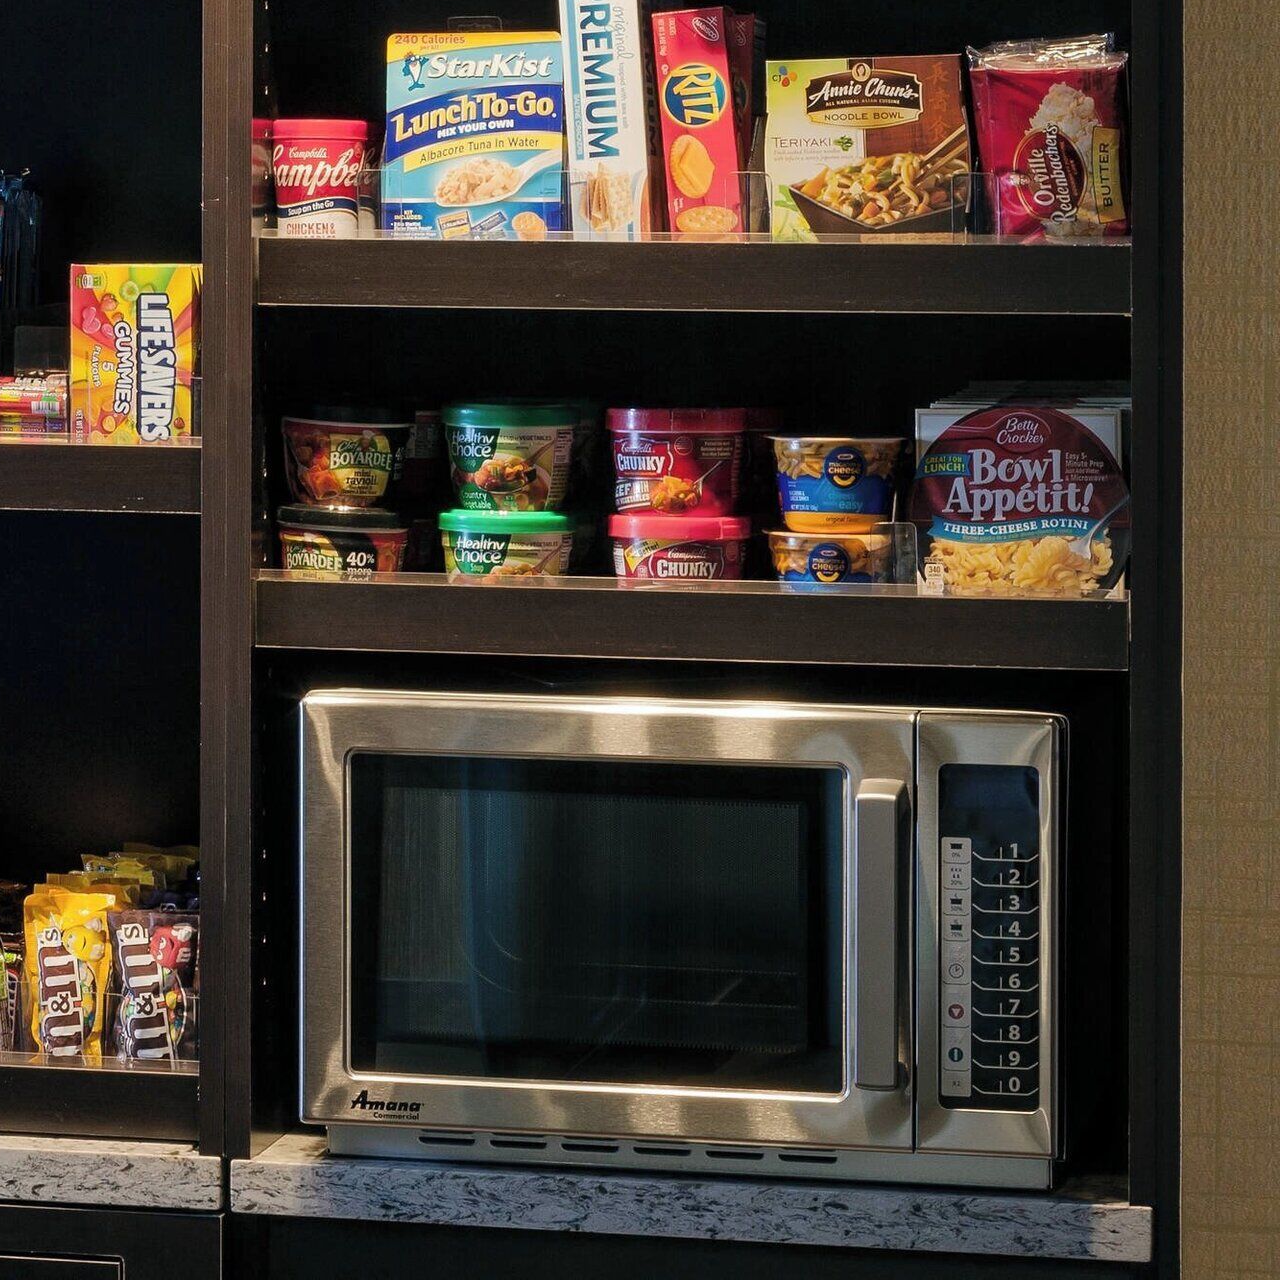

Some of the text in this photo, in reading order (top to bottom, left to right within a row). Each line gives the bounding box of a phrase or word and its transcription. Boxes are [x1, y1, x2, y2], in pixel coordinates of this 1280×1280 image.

[607, 6, 635, 61] original
[694, 18, 719, 40] NABISCO
[395, 34, 466, 45] 240 Calories
[426, 49, 554, 79] StarKist
[772, 74, 782, 83] CJ
[672, 63, 720, 125] RITZ
[807, 77, 919, 108] Annie Chun's
[390, 93, 477, 143] Lunch
[824, 111, 905, 121] NOODLE BOWL
[437, 119, 515, 139] MIX YOUR OWN
[419, 137, 540, 165] Albacore Tuna In Water
[772, 137, 832, 148] TERIYAKI
[1028, 148, 1056, 206] Orville
[1042, 122, 1078, 223] Redenbacher's
[1099, 142, 1113, 208] BUTTER
[288, 200, 335, 217] Soup on the Go
[286, 222, 336, 235] CHICKEN &
[89, 344, 102, 388] FLAVORS
[101, 362, 114, 372] 5
[113, 321, 134, 416] GUMMIES
[1005, 418, 1039, 435] Betty
[452, 428, 495, 444] Healthy
[996, 430, 1046, 445] Crocker
[451, 442, 494, 458] Choice
[1065, 452, 1079, 462] Easy
[329, 451, 393, 471] BOYARDEE
[617, 453, 666, 474] CHUNKY
[924, 462, 966, 473] LUNCH!
[1065, 459, 1104, 469] Minute Prep
[345, 476, 377, 486] ravioli
[942, 476, 1095, 521] Appétit!
[942, 518, 1089, 536] THREE-CHEESE ROTINI
[456, 534, 506, 550] Healthy
[286, 552, 344, 572] BOYARDEE
[346, 551, 375, 567] 40%
[453, 549, 503, 564] Choice
[346, 566, 373, 576] more
[656, 559, 718, 579] CHUNKY
[927, 564, 941, 574] 340
[1009, 842, 1019, 859] 1
[1008, 868, 1021, 884] 2
[1008, 894, 1021, 911] 3
[1007, 920, 1022, 937] 4
[1008, 946, 1021, 963] 5
[1008, 972, 1021, 989] 6
[1008, 998, 1021, 1015] 7
[1008, 1024, 1021, 1041] 8
[1008, 1050, 1021, 1067] 9
[1008, 1076, 1021, 1093] 0
[350, 1089, 422, 1113] Amana
[372, 1111, 420, 1121] Commercial
